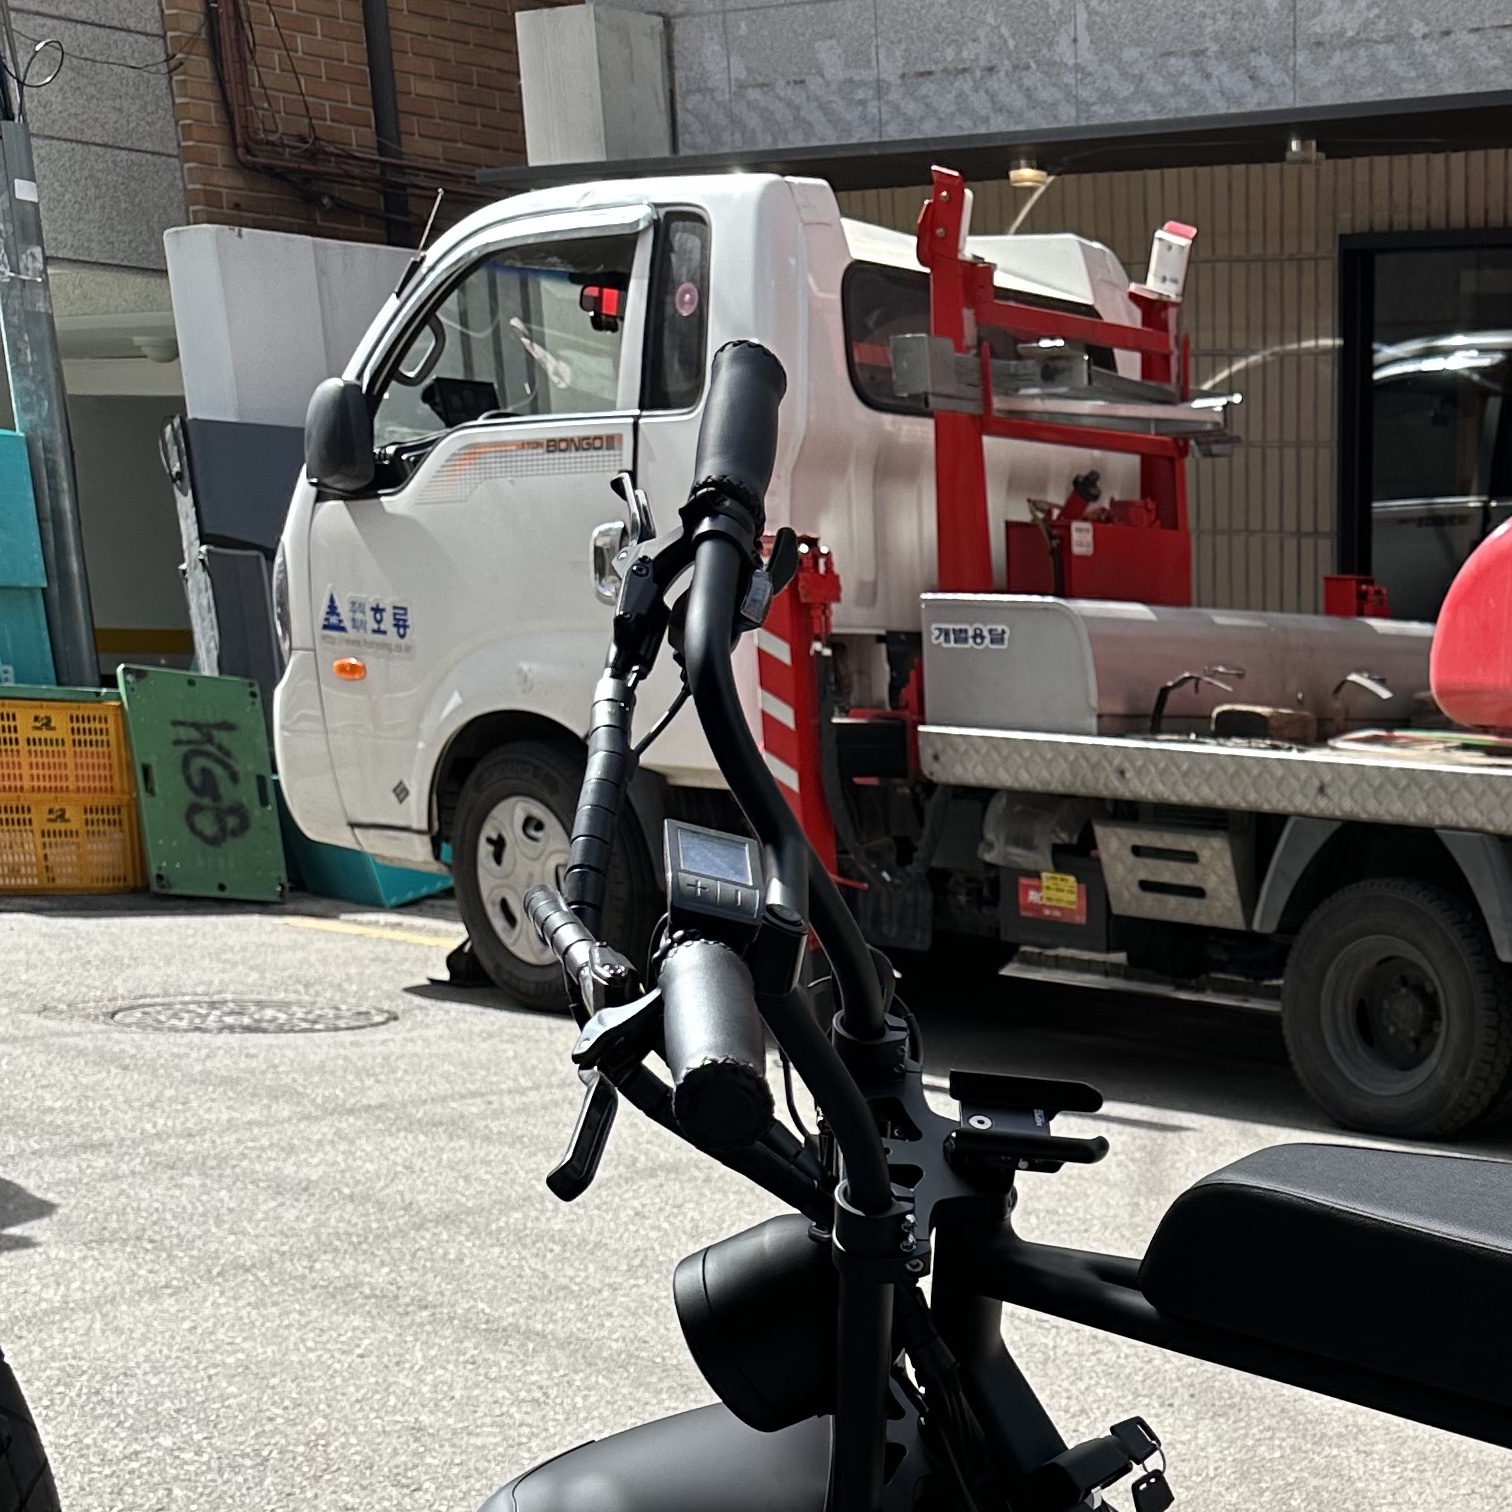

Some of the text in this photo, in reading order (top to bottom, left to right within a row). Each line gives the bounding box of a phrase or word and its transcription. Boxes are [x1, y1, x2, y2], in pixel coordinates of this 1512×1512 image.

[546, 435, 603, 453] BONGO
[370, 603, 410, 640] 호룡
[932, 626, 1008, 648] 개별용달
[170, 719, 250, 847] KGB
